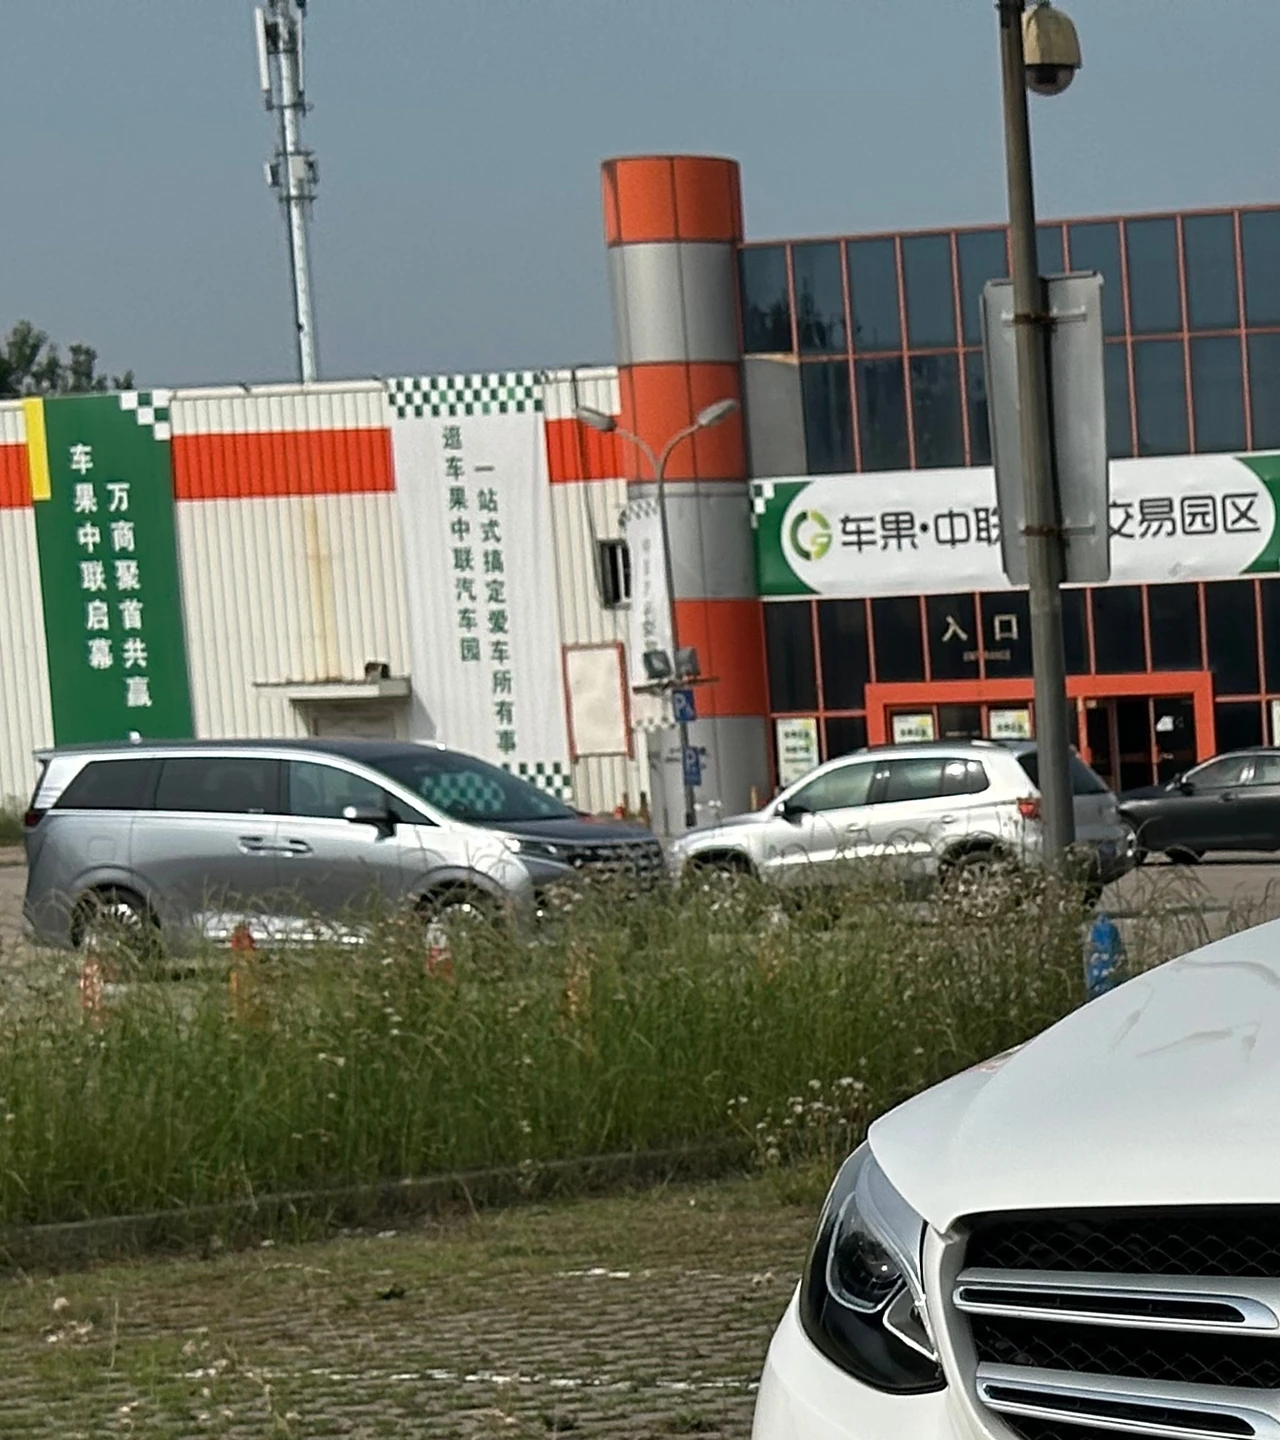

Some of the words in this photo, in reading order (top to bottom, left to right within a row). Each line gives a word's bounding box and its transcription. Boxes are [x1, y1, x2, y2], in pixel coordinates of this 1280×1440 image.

[69, 443, 113, 669] 车果中联启幕
[106, 481, 152, 708] 万商聚首共赢
[474, 465, 516, 755] 一站式搞定爱车所有事
[942, 614, 1018, 641] 入口
